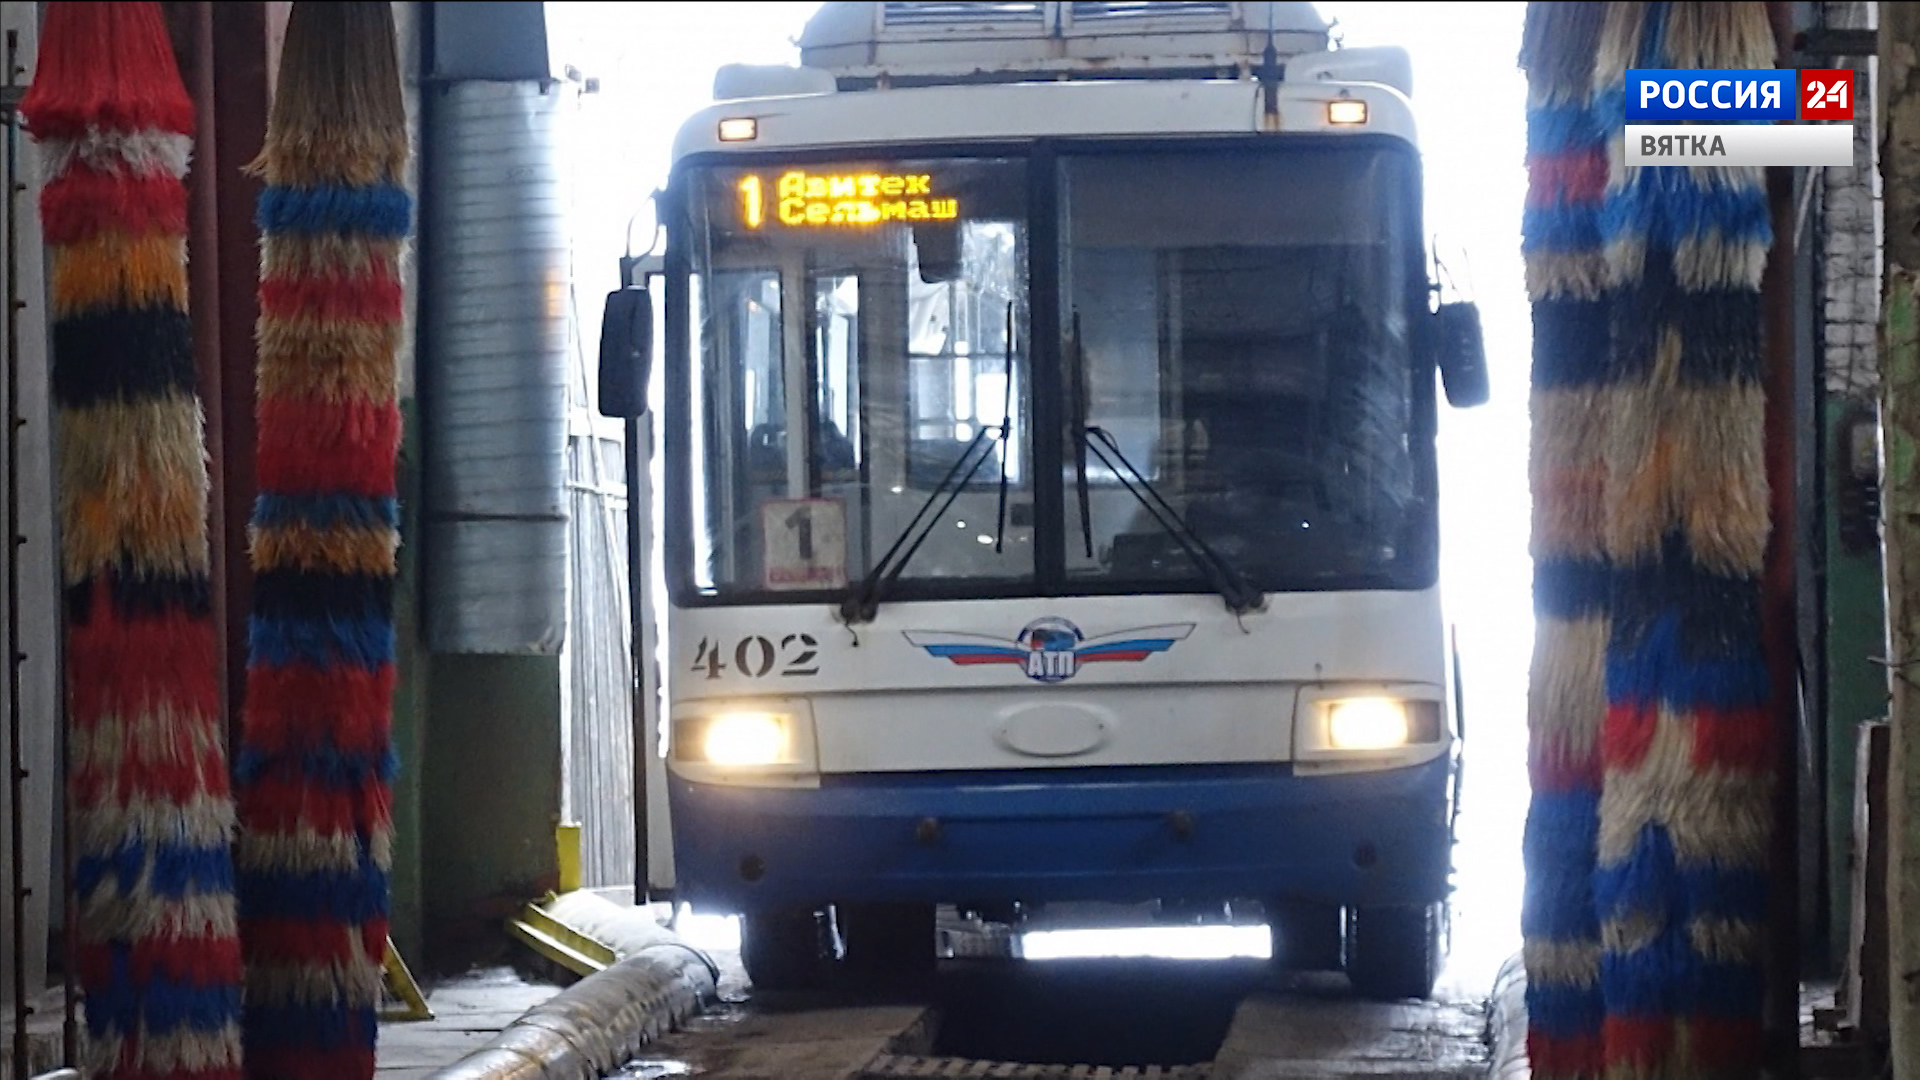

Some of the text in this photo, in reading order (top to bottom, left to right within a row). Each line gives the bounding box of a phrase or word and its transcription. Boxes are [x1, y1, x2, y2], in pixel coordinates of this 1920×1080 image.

[740, 175, 762, 228] 1
[779, 172, 930, 198] Авитек
[779, 199, 958, 226] Сельмаш
[785, 505, 812, 559] 1
[690, 633, 820, 679] 402
[1027, 650, 1074, 676] АТП
